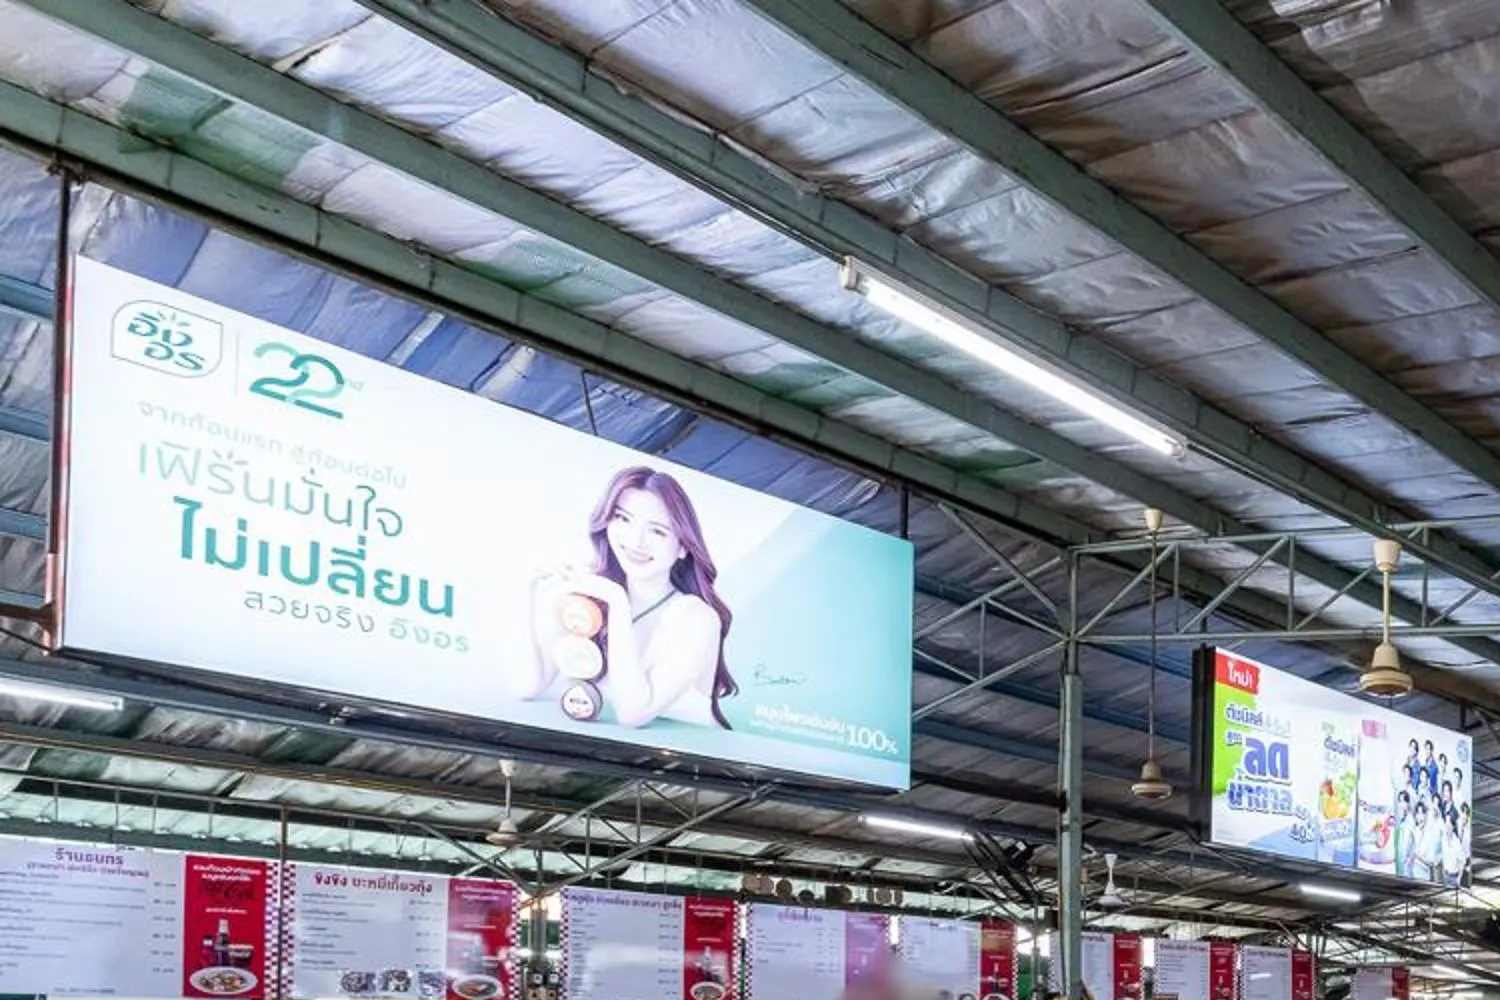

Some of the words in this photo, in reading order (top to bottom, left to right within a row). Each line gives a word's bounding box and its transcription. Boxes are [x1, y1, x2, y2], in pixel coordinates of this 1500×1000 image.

[172, 495, 456, 618] ไม่เปลี่ยน
[244, 589, 376, 634] สวยจริง
[389, 618, 471, 653] อิงอร
[1243, 736, 1291, 781] ลด
